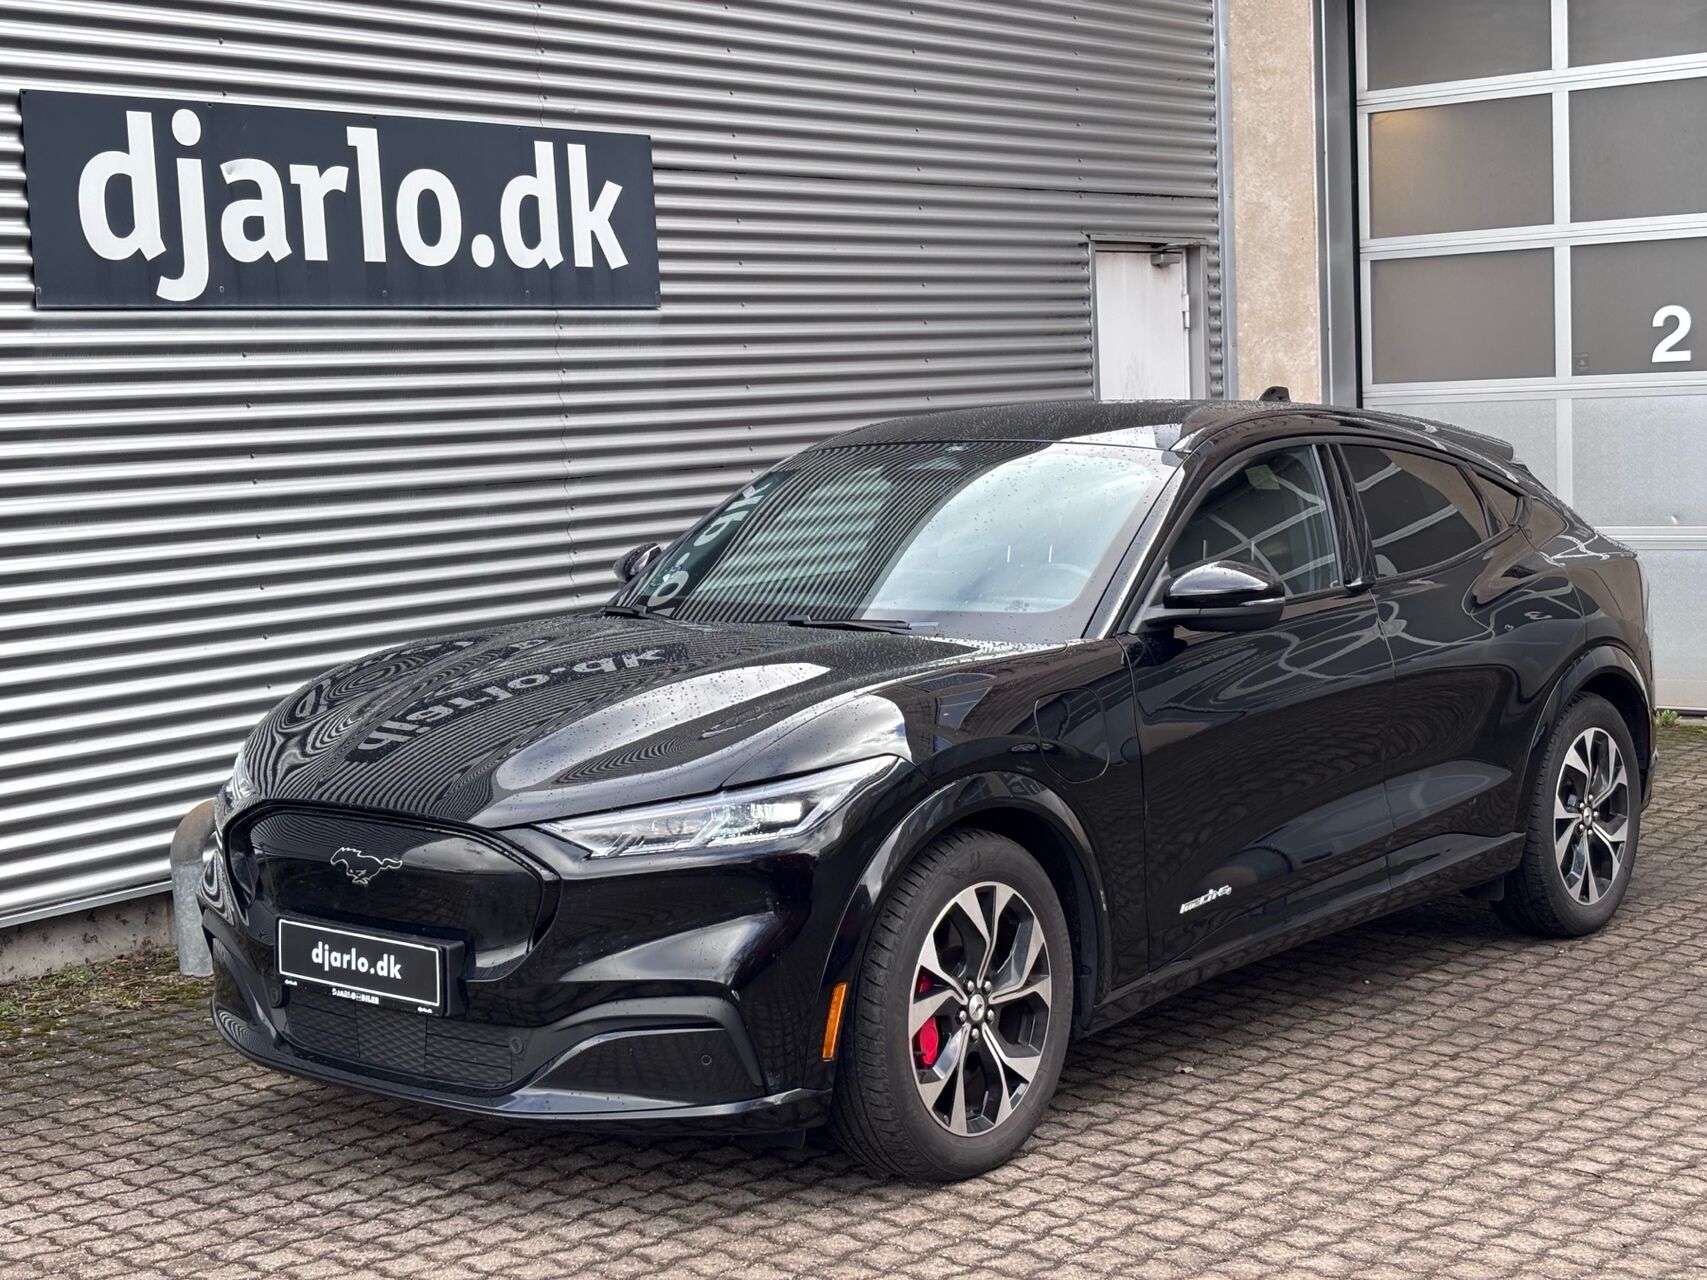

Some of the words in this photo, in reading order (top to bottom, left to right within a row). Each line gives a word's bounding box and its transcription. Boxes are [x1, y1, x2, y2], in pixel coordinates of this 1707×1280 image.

[78, 108, 629, 302] djarlo.dk
[1652, 304, 1692, 363] 2
[311, 941, 402, 979] djarlo.dk
